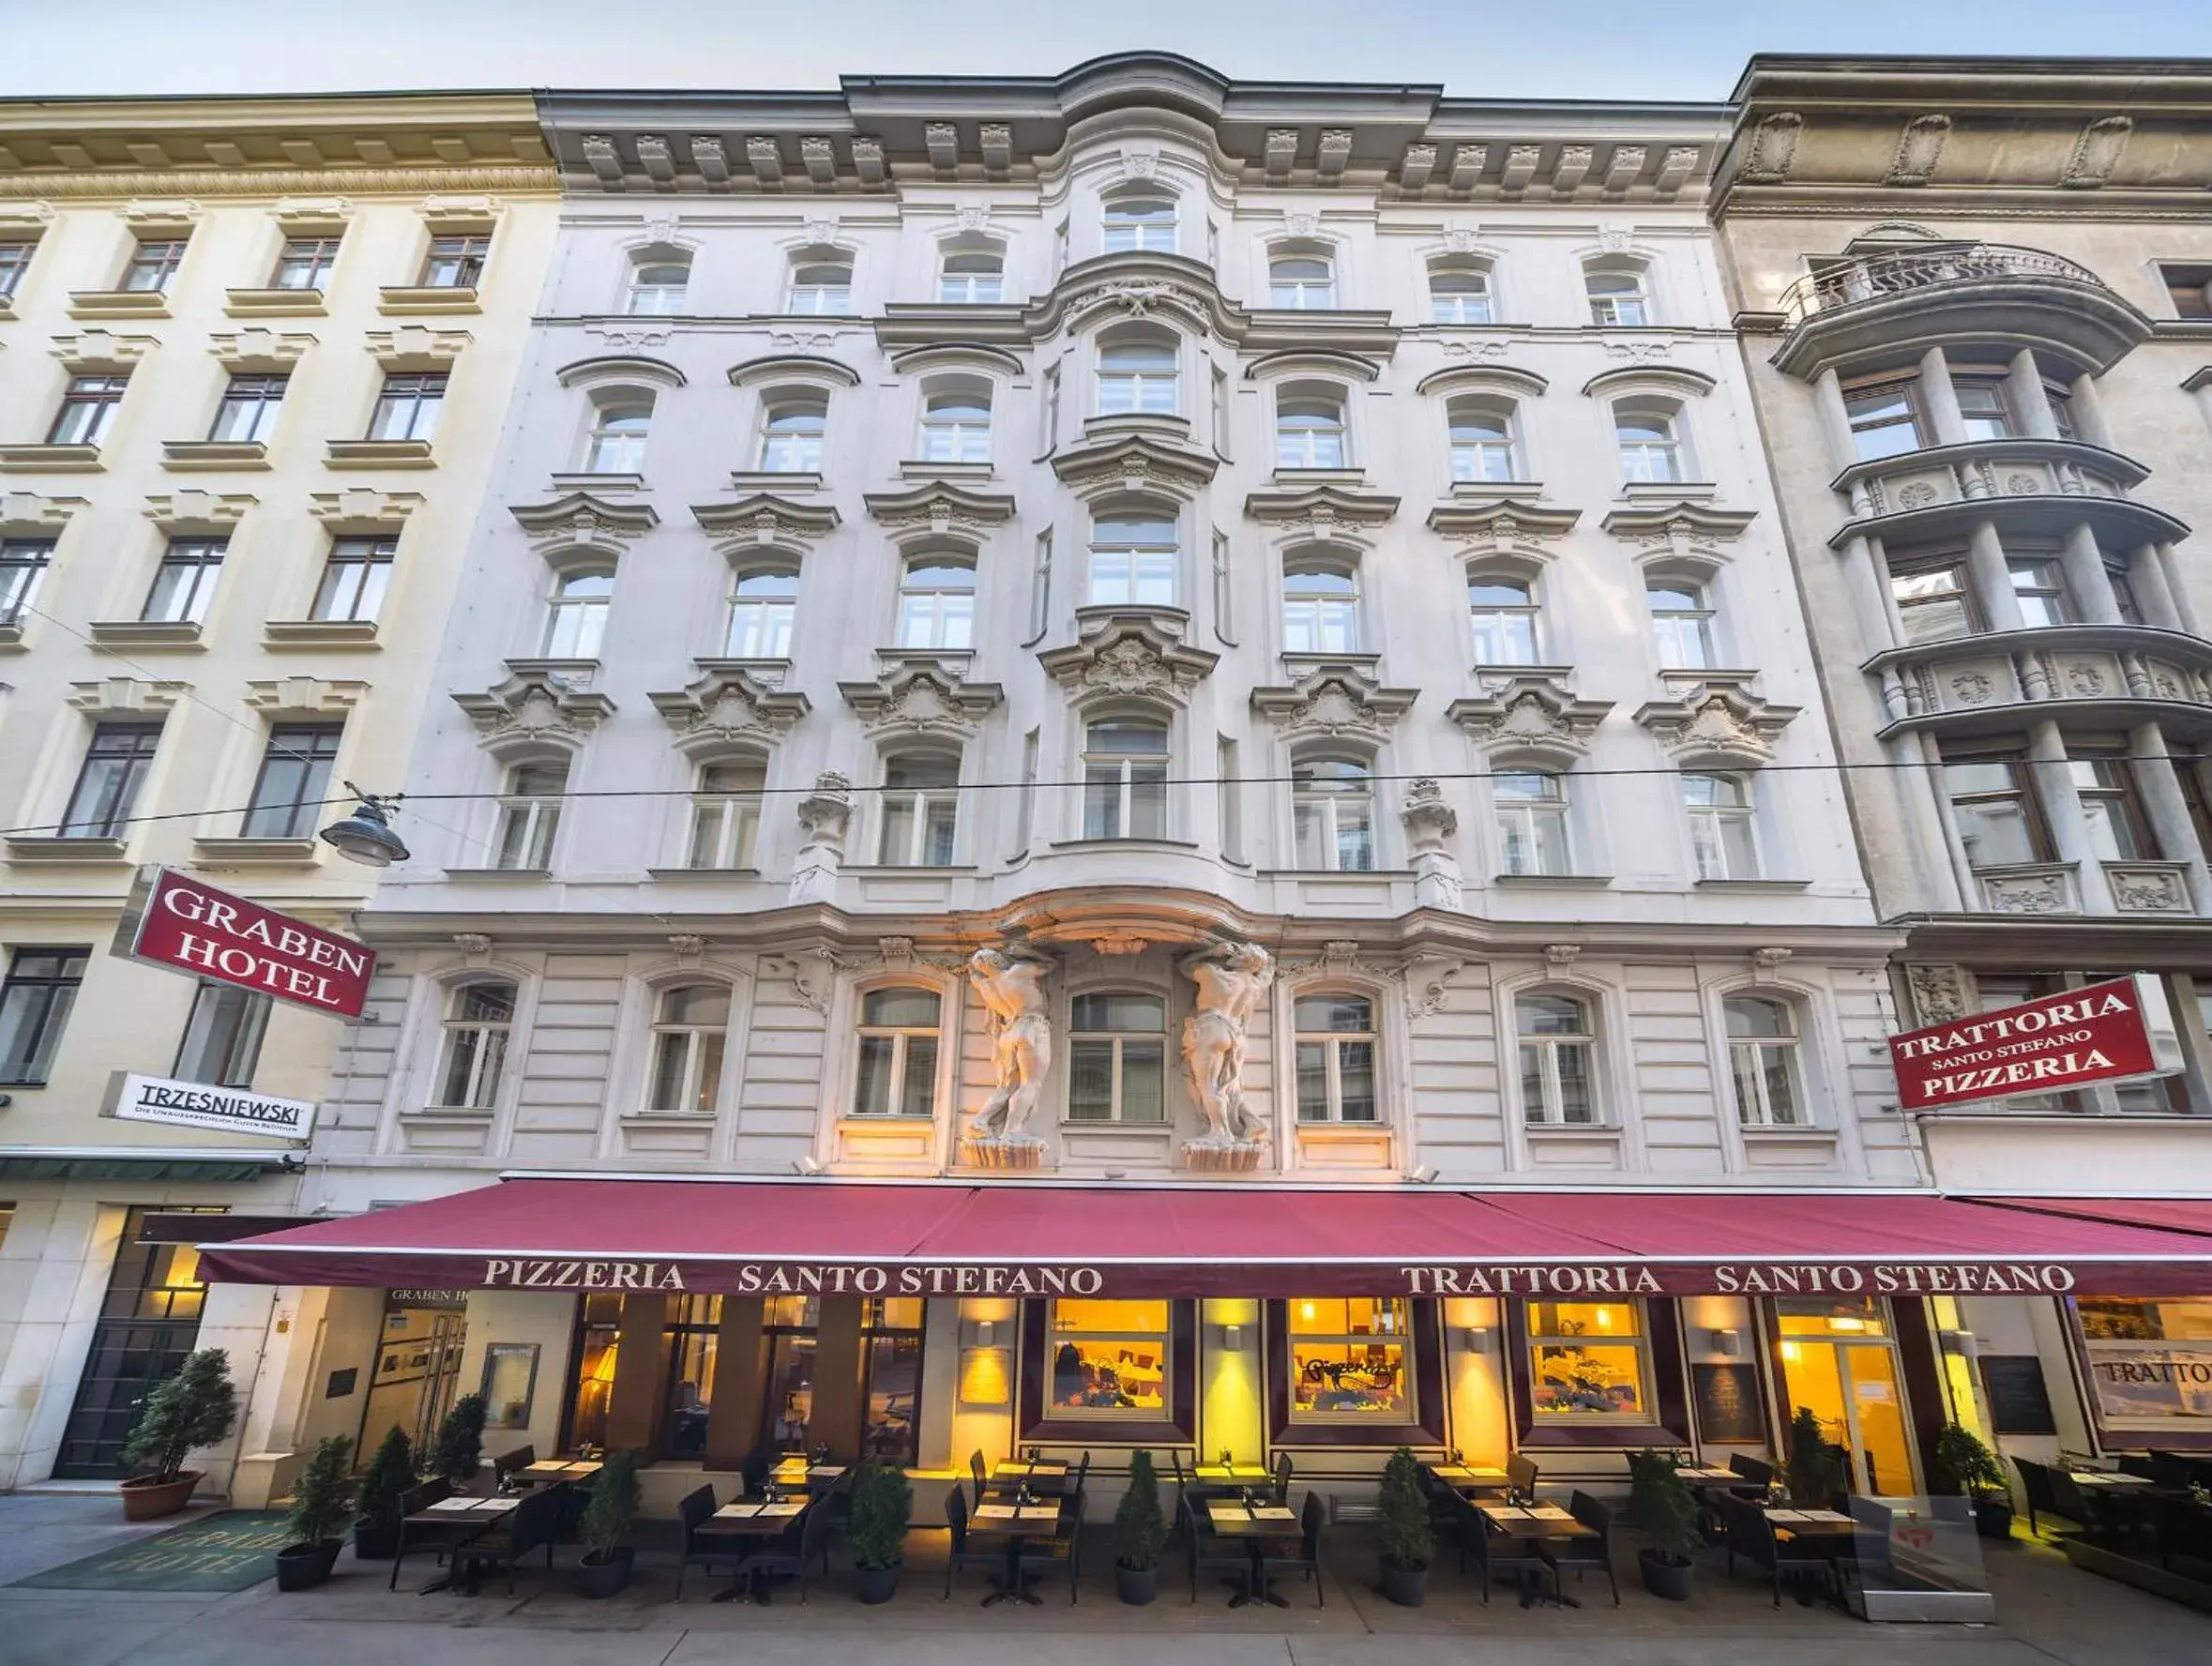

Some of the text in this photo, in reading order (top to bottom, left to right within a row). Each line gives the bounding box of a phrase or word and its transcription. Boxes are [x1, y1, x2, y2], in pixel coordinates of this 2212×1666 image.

[164, 887, 369, 977] GRABEN
[174, 931, 340, 1005] HOTEL
[1897, 993, 2132, 1059] TRATTORIA
[1932, 1029, 2092, 1071] SANTO STEFANO
[1922, 1049, 2115, 1098] PIZZERIA
[391, 1288, 452, 1301] GRABEN
[479, 1259, 2076, 1295] PIZZERIA SANTO STEFANO TRATTORIA SANTO STEFANO
